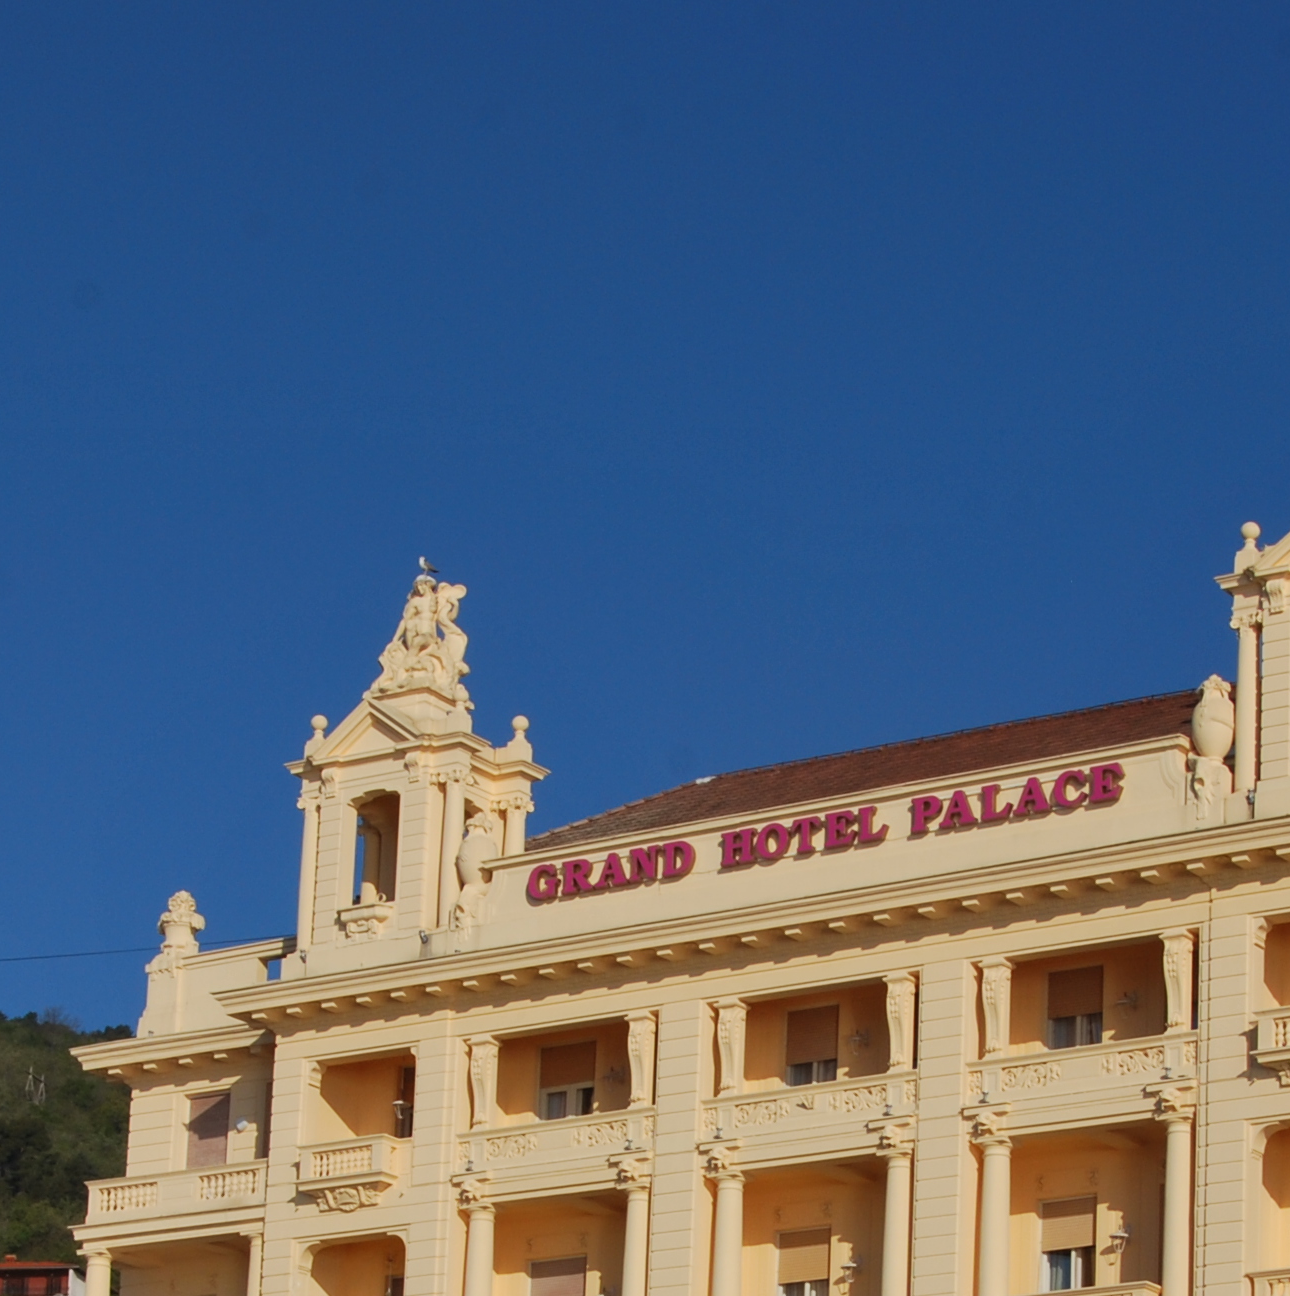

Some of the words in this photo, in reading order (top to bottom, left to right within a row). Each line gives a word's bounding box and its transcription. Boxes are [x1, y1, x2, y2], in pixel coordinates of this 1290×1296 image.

[526, 840, 697, 902] GRAND
[719, 805, 890, 868] HOTEL
[910, 762, 1126, 835] PALACE
